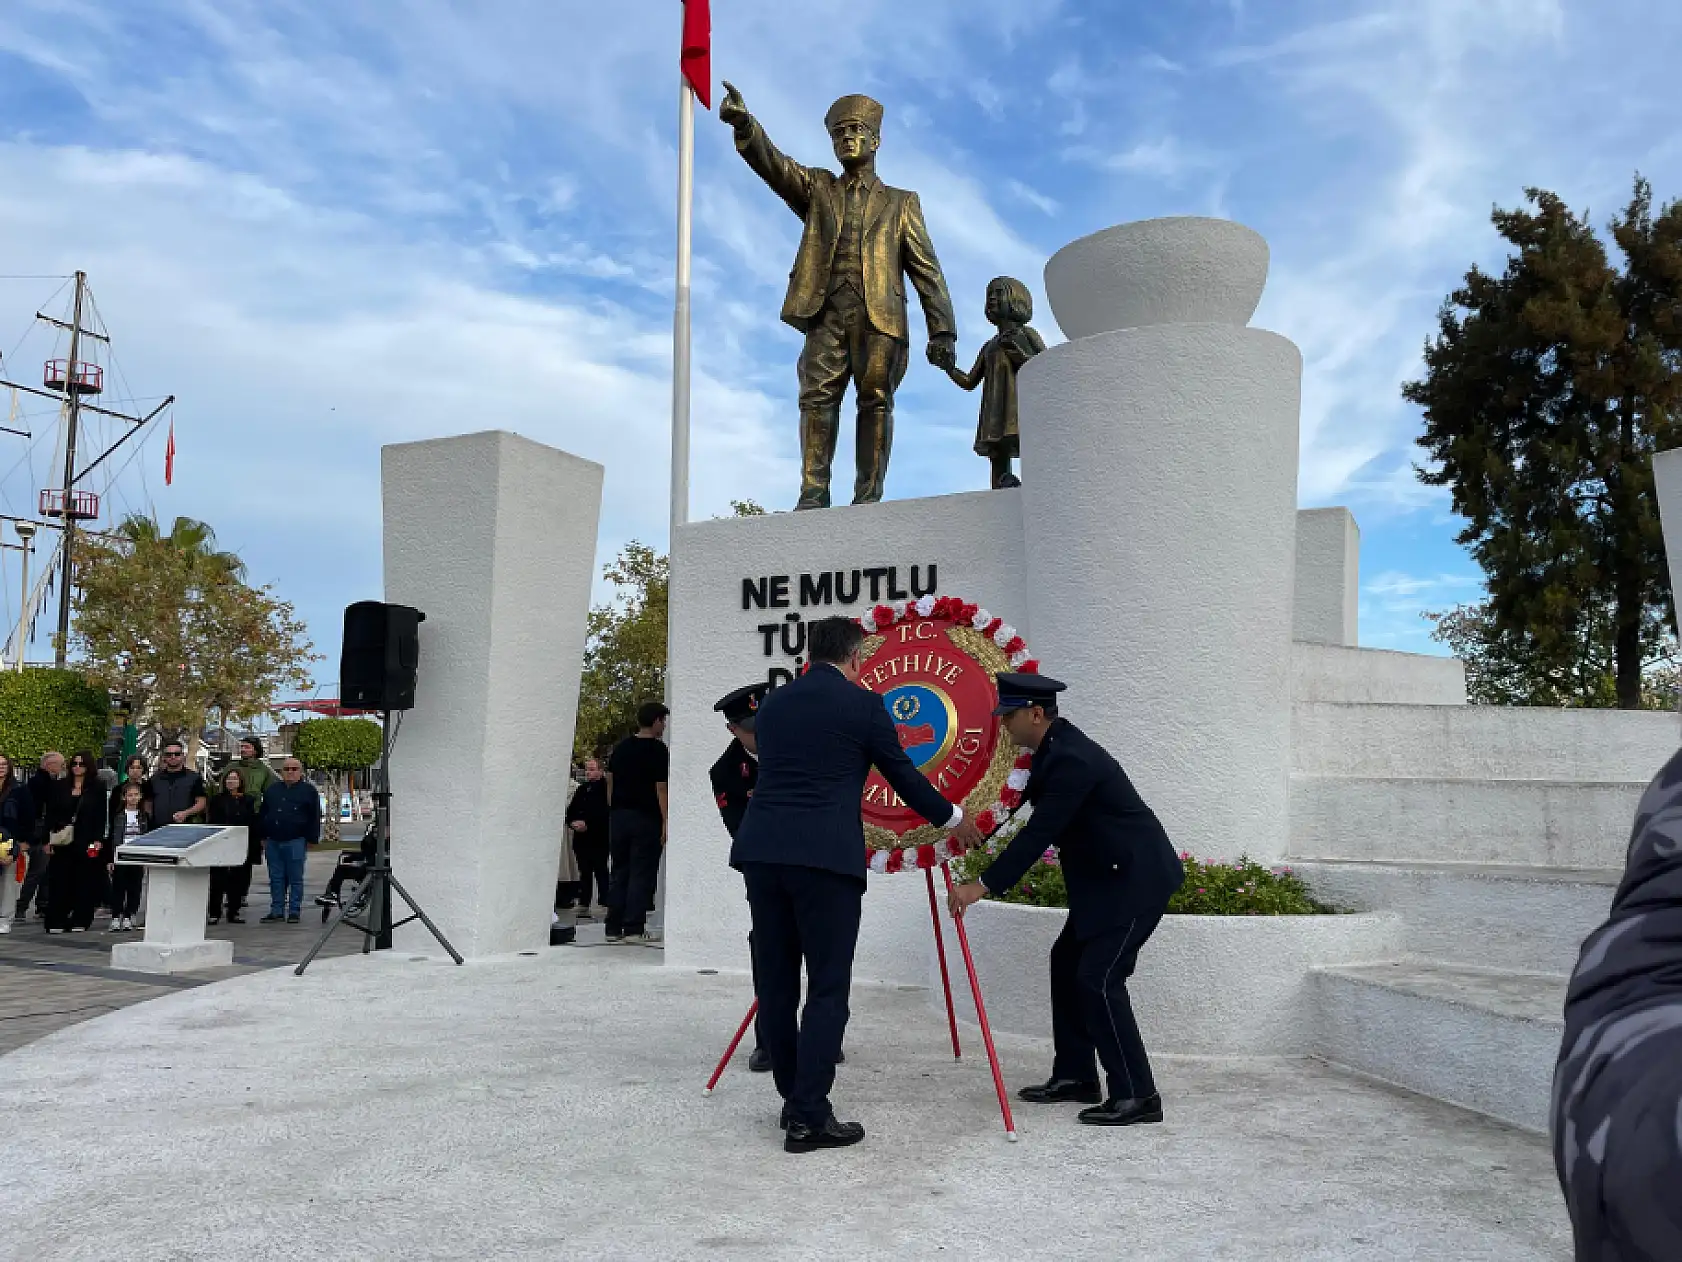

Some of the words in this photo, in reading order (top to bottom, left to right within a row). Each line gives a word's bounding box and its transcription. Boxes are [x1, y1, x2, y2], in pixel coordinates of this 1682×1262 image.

[742, 575, 790, 610] NE
[800, 564, 938, 606] MUTLU
[896, 621, 938, 643] T.C.
[860, 650, 963, 691] FETHİYE
